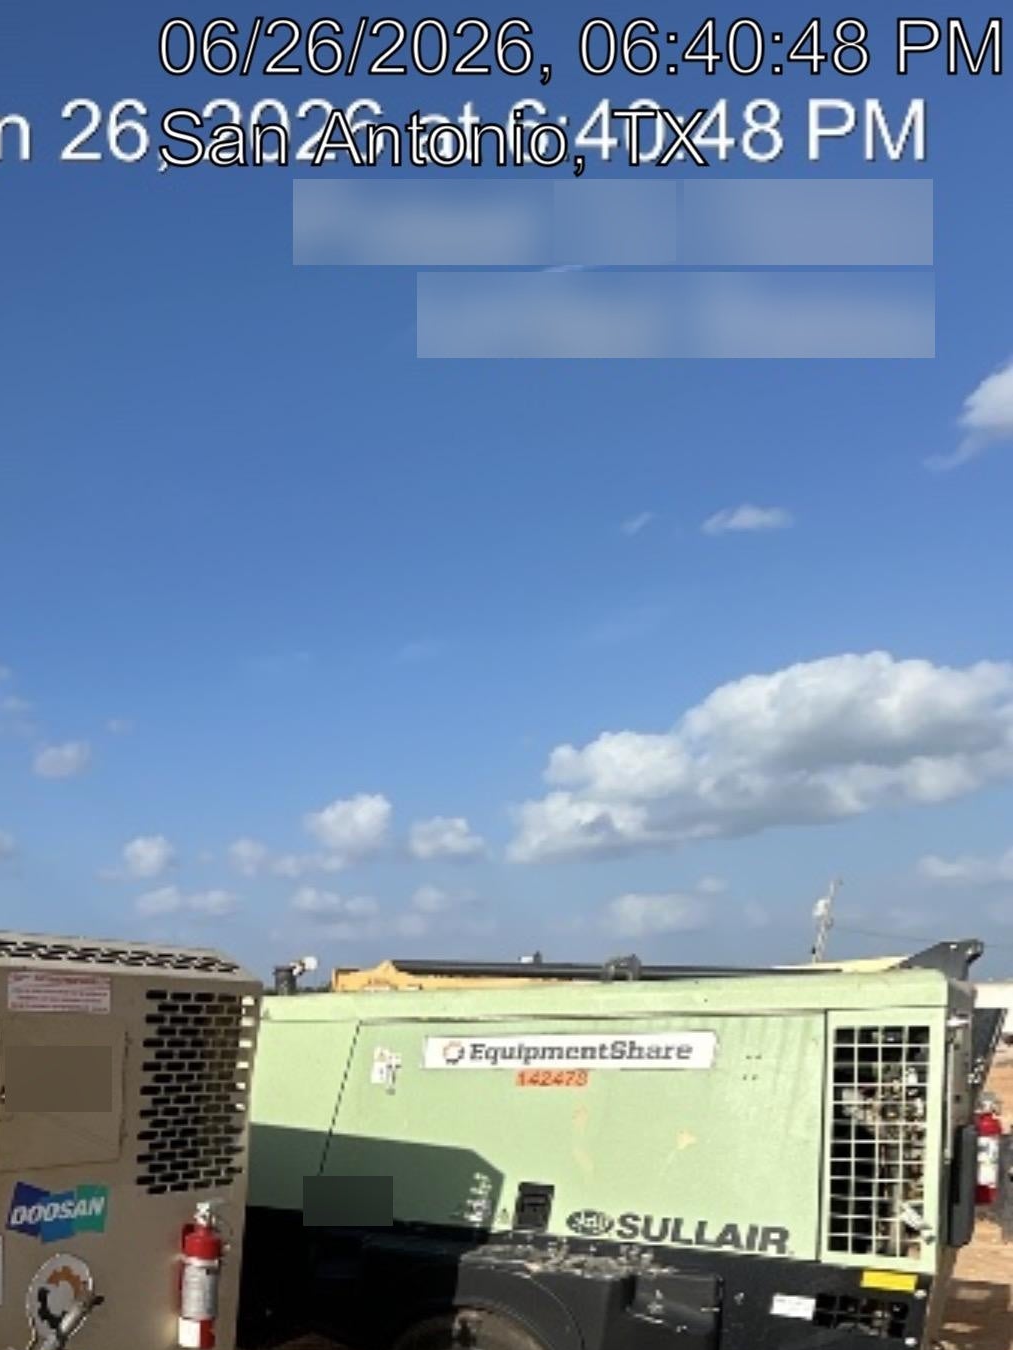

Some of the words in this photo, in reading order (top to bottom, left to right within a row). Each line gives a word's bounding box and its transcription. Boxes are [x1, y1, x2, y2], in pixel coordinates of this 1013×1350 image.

[469, 1040, 693, 1066] EquipmentShare
[10, 1196, 106, 1226] DOOSAN
[615, 1211, 791, 1255] SULLAIR
